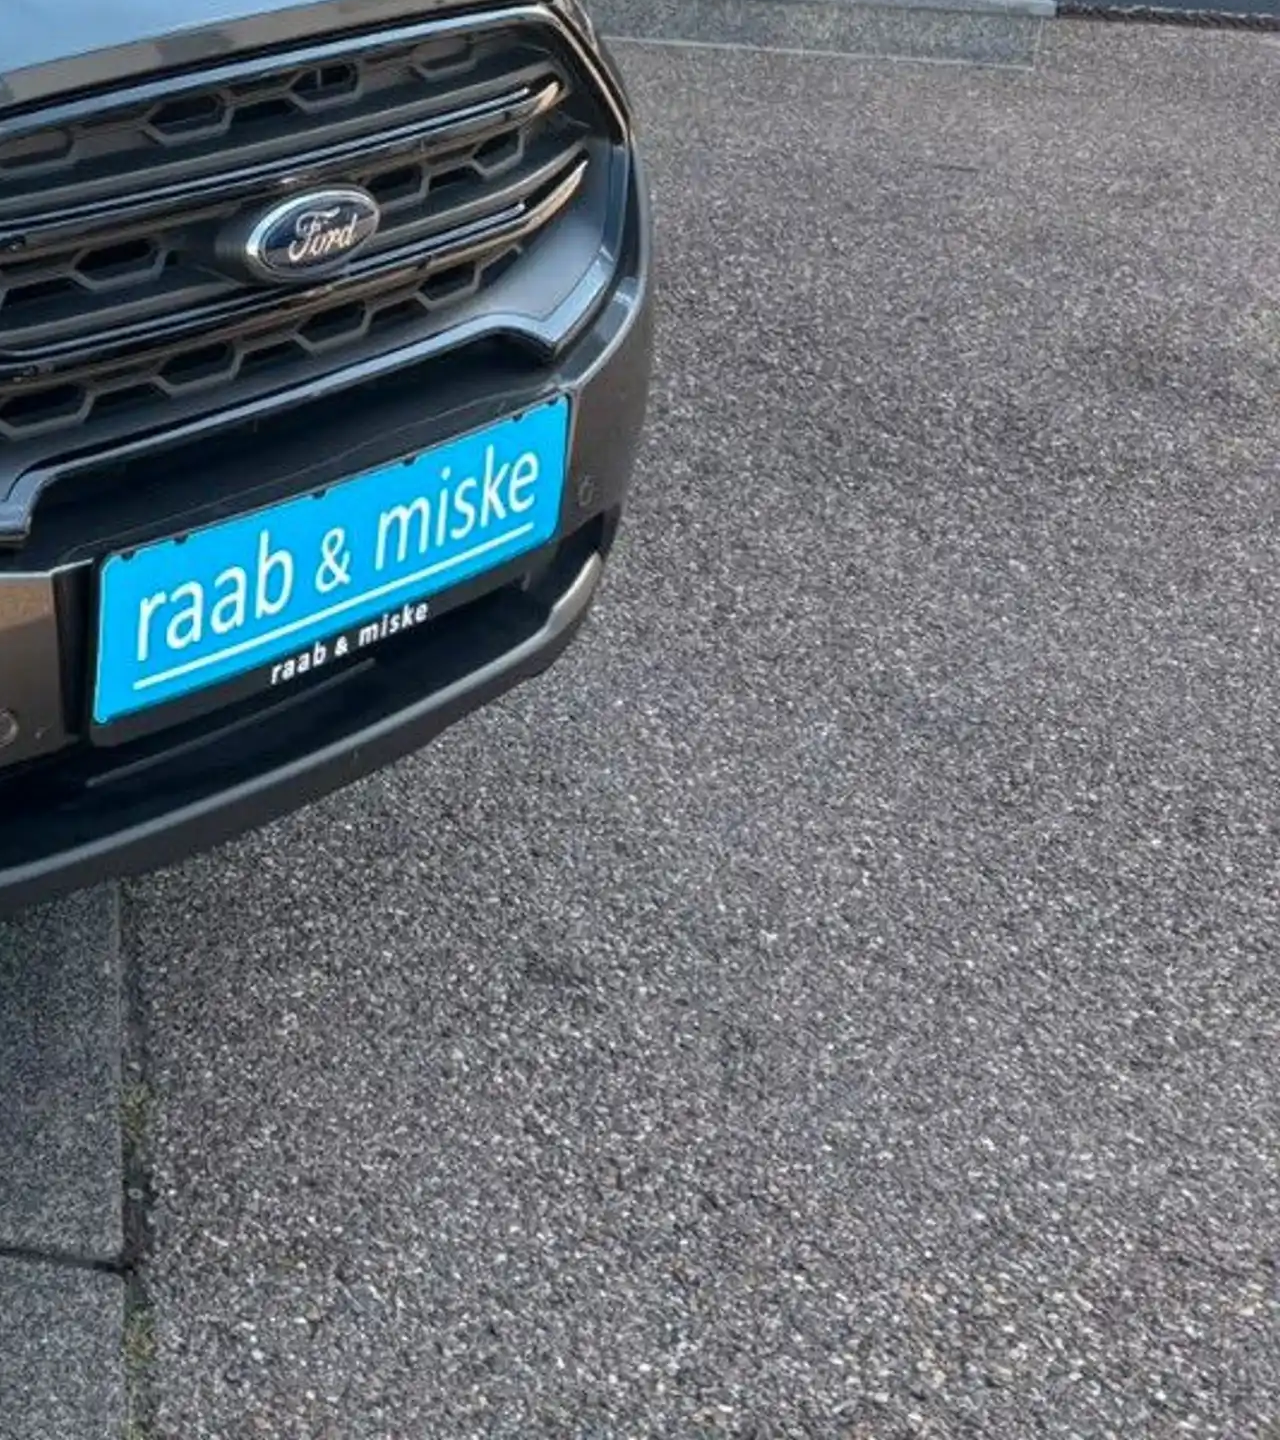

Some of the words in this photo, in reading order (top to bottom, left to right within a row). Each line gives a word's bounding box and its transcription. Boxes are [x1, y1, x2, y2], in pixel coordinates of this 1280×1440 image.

[287, 206, 359, 262] Ford
[135, 529, 294, 662] raab
[314, 526, 352, 594] &
[374, 443, 540, 571] miske
[270, 643, 327, 685] raab
[334, 636, 349, 655] &
[358, 601, 430, 645] miske
